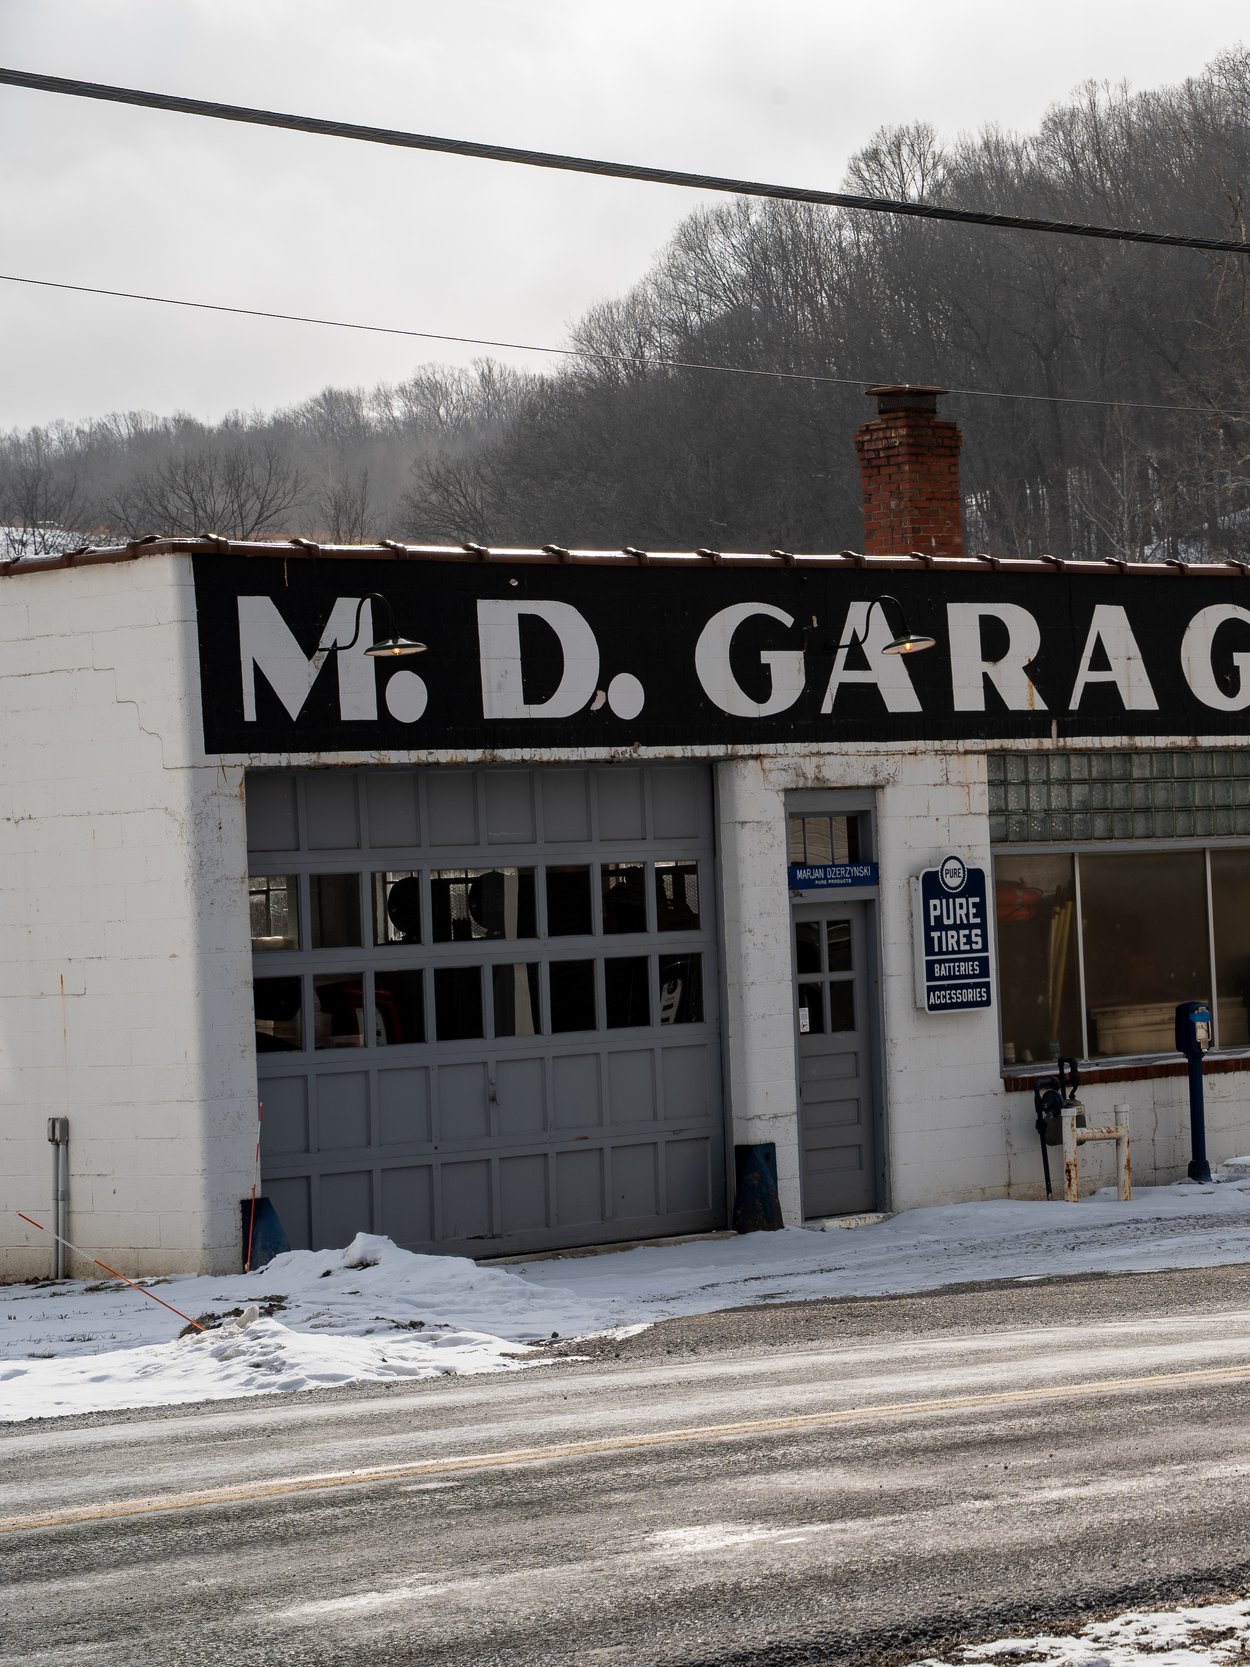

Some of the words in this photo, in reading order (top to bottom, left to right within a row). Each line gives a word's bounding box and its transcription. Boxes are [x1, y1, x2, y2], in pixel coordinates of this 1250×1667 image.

[237, 595, 428, 723] M.
[477, 599, 645, 720] D.
[826, 866, 871, 878] DZERZYNSKI
[944, 867, 962, 879] PURE
[929, 897, 981, 926] PURE
[930, 929, 983, 953] TIRES
[934, 961, 980, 977] BATTERIES
[929, 988, 987, 1005] ACCESSORIES
